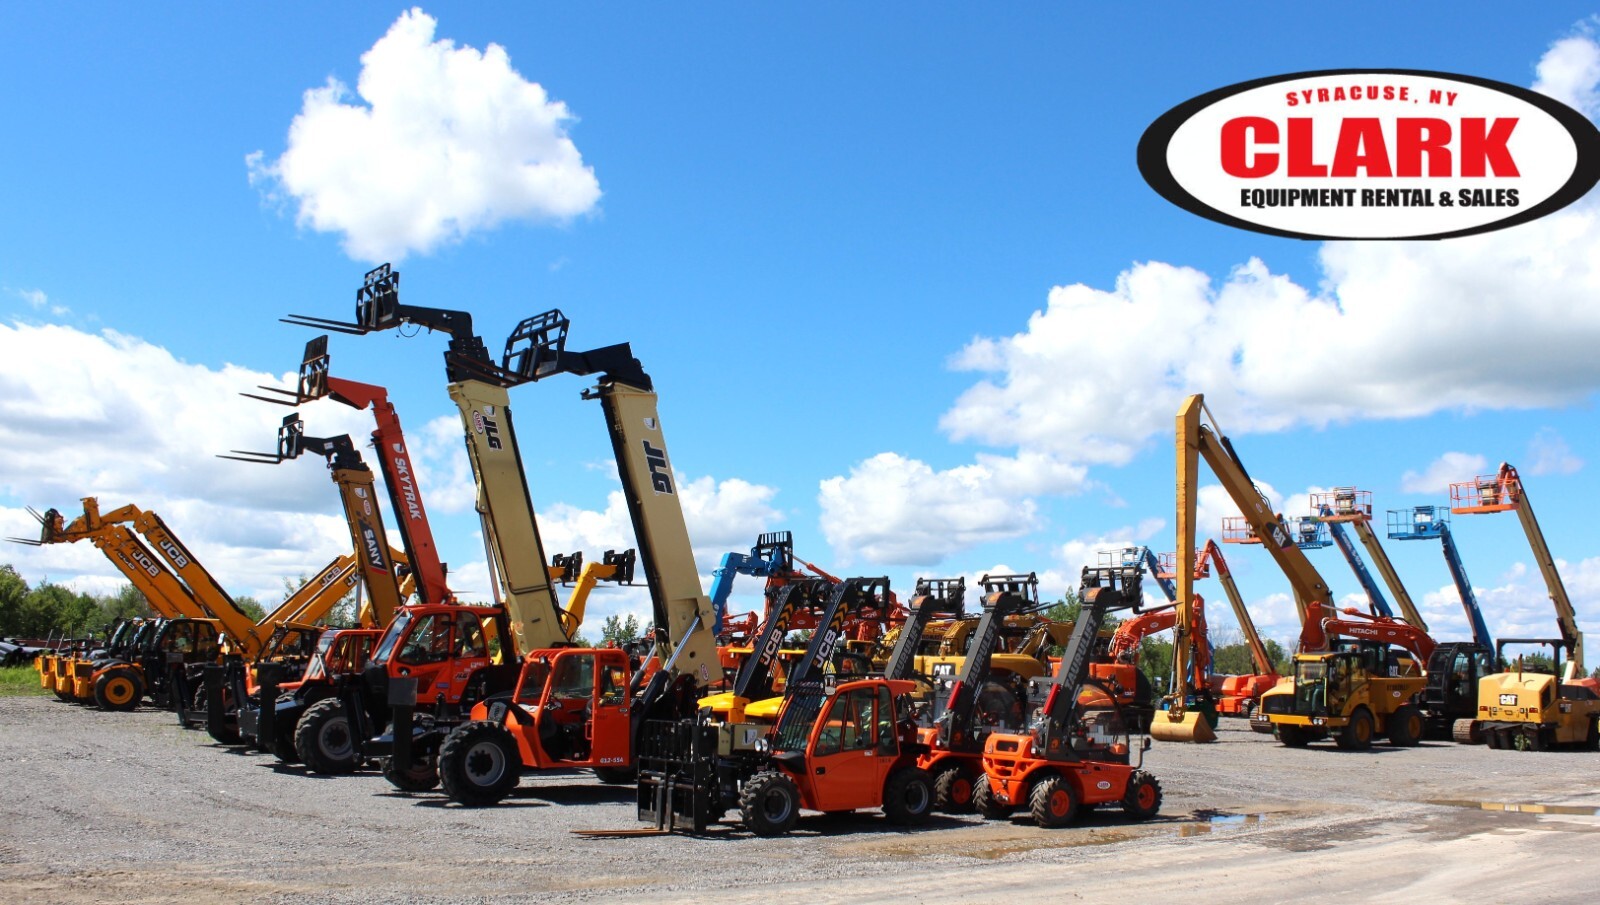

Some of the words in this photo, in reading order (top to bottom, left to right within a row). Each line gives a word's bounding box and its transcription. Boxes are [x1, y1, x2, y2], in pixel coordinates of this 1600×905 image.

[483, 416, 502, 451] JLG
[642, 439, 673, 495] JLG
[394, 457, 421, 520] SKYTRAK
[364, 529, 382, 566] SANY
[1273, 526, 1287, 547] CAT
[132, 551, 160, 577] JCB
[160, 540, 188, 568] JCB
[320, 566, 341, 587] JCB
[1349, 627, 1378, 635] HITACHI
[763, 628, 783, 666] JCB
[816, 629, 837, 668] JCB
[1065, 618, 1097, 690] TAURULIFT
[934, 664, 951, 677] CAT
[1500, 694, 1516, 705] CAT
